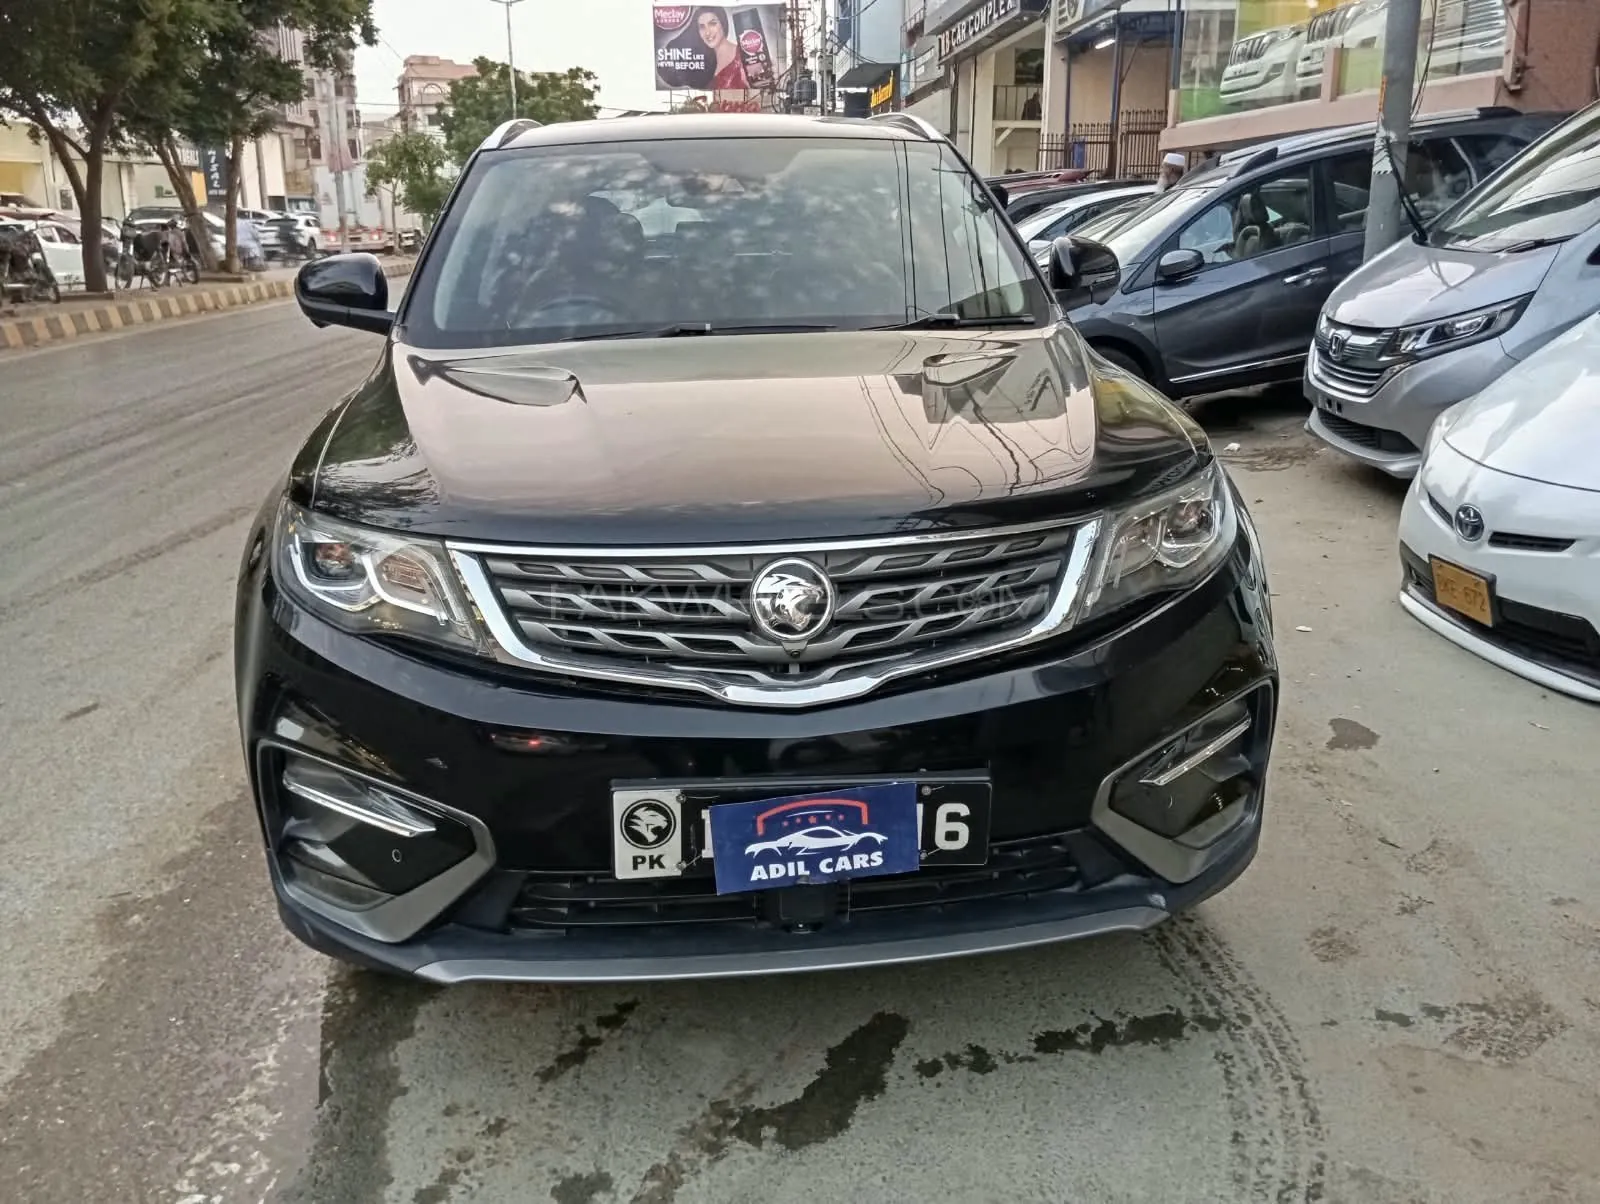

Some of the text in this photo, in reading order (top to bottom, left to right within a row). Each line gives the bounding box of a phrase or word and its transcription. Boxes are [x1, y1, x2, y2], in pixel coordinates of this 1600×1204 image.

[951, 21, 966, 46] CAR
[657, 47, 692, 61] SHINE
[675, 61, 705, 70] BEFORE
[632, 855, 666, 871] PK
[749, 850, 885, 882] ADIL CARS
